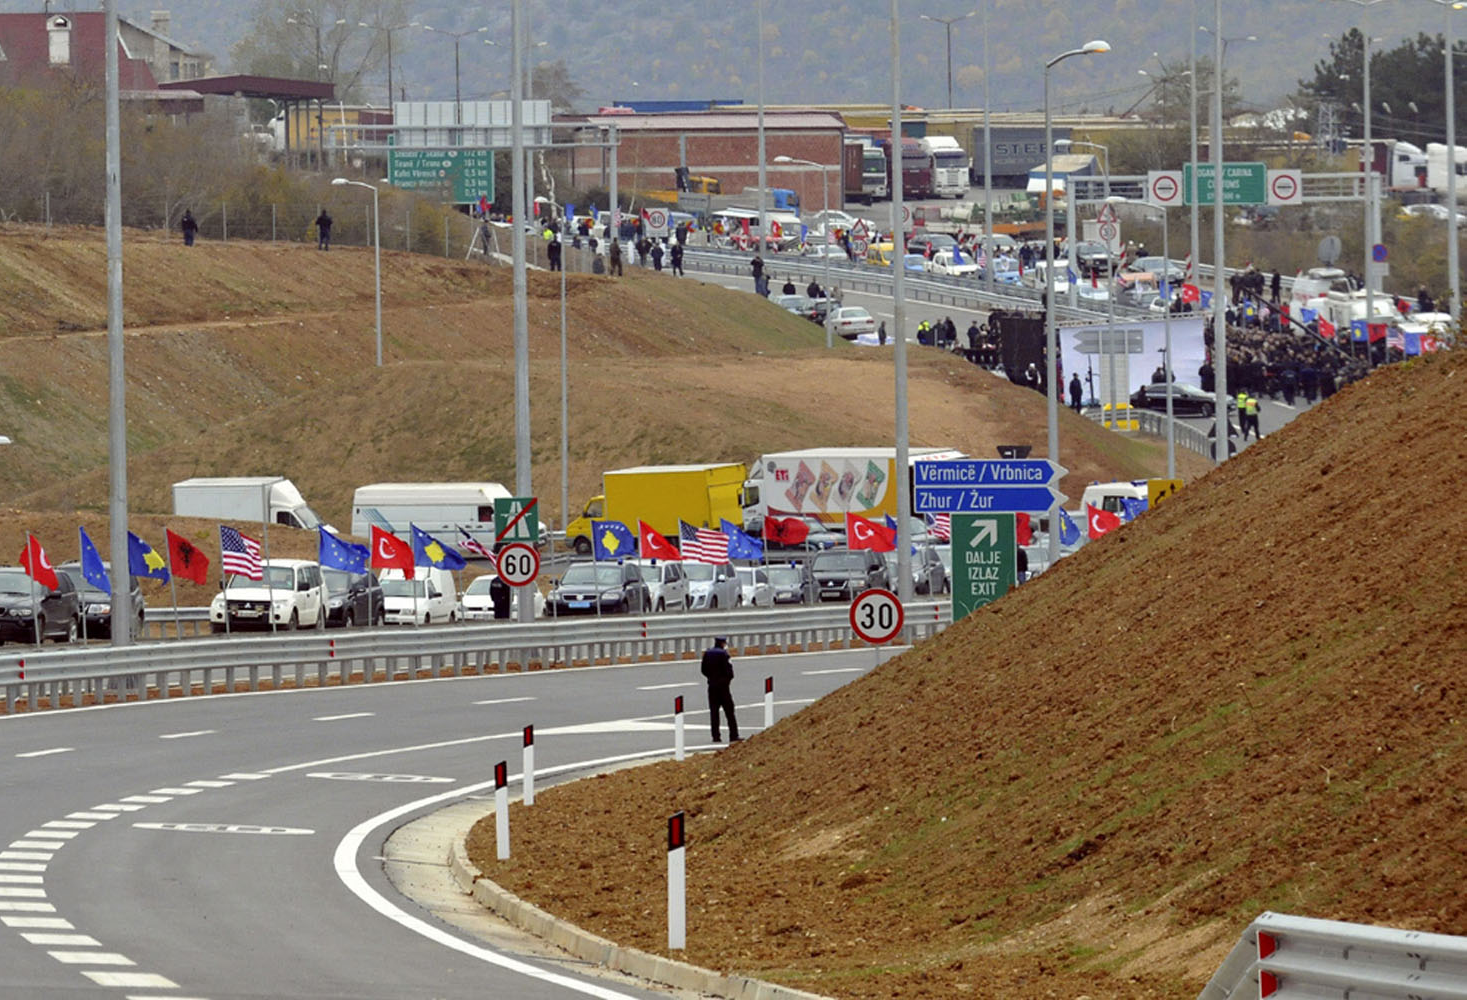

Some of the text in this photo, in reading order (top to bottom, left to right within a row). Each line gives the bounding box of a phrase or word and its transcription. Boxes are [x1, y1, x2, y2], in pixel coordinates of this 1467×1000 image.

[919, 463, 1043, 482] Vërmicë / Vrbnica
[919, 489, 994, 510] Zhur / Žur
[505, 554, 531, 576] 60
[965, 551, 1001, 564] DALJE
[968, 567, 999, 580] IZLAZ
[971, 582, 997, 595] EXIT
[860, 602, 893, 630] 30
